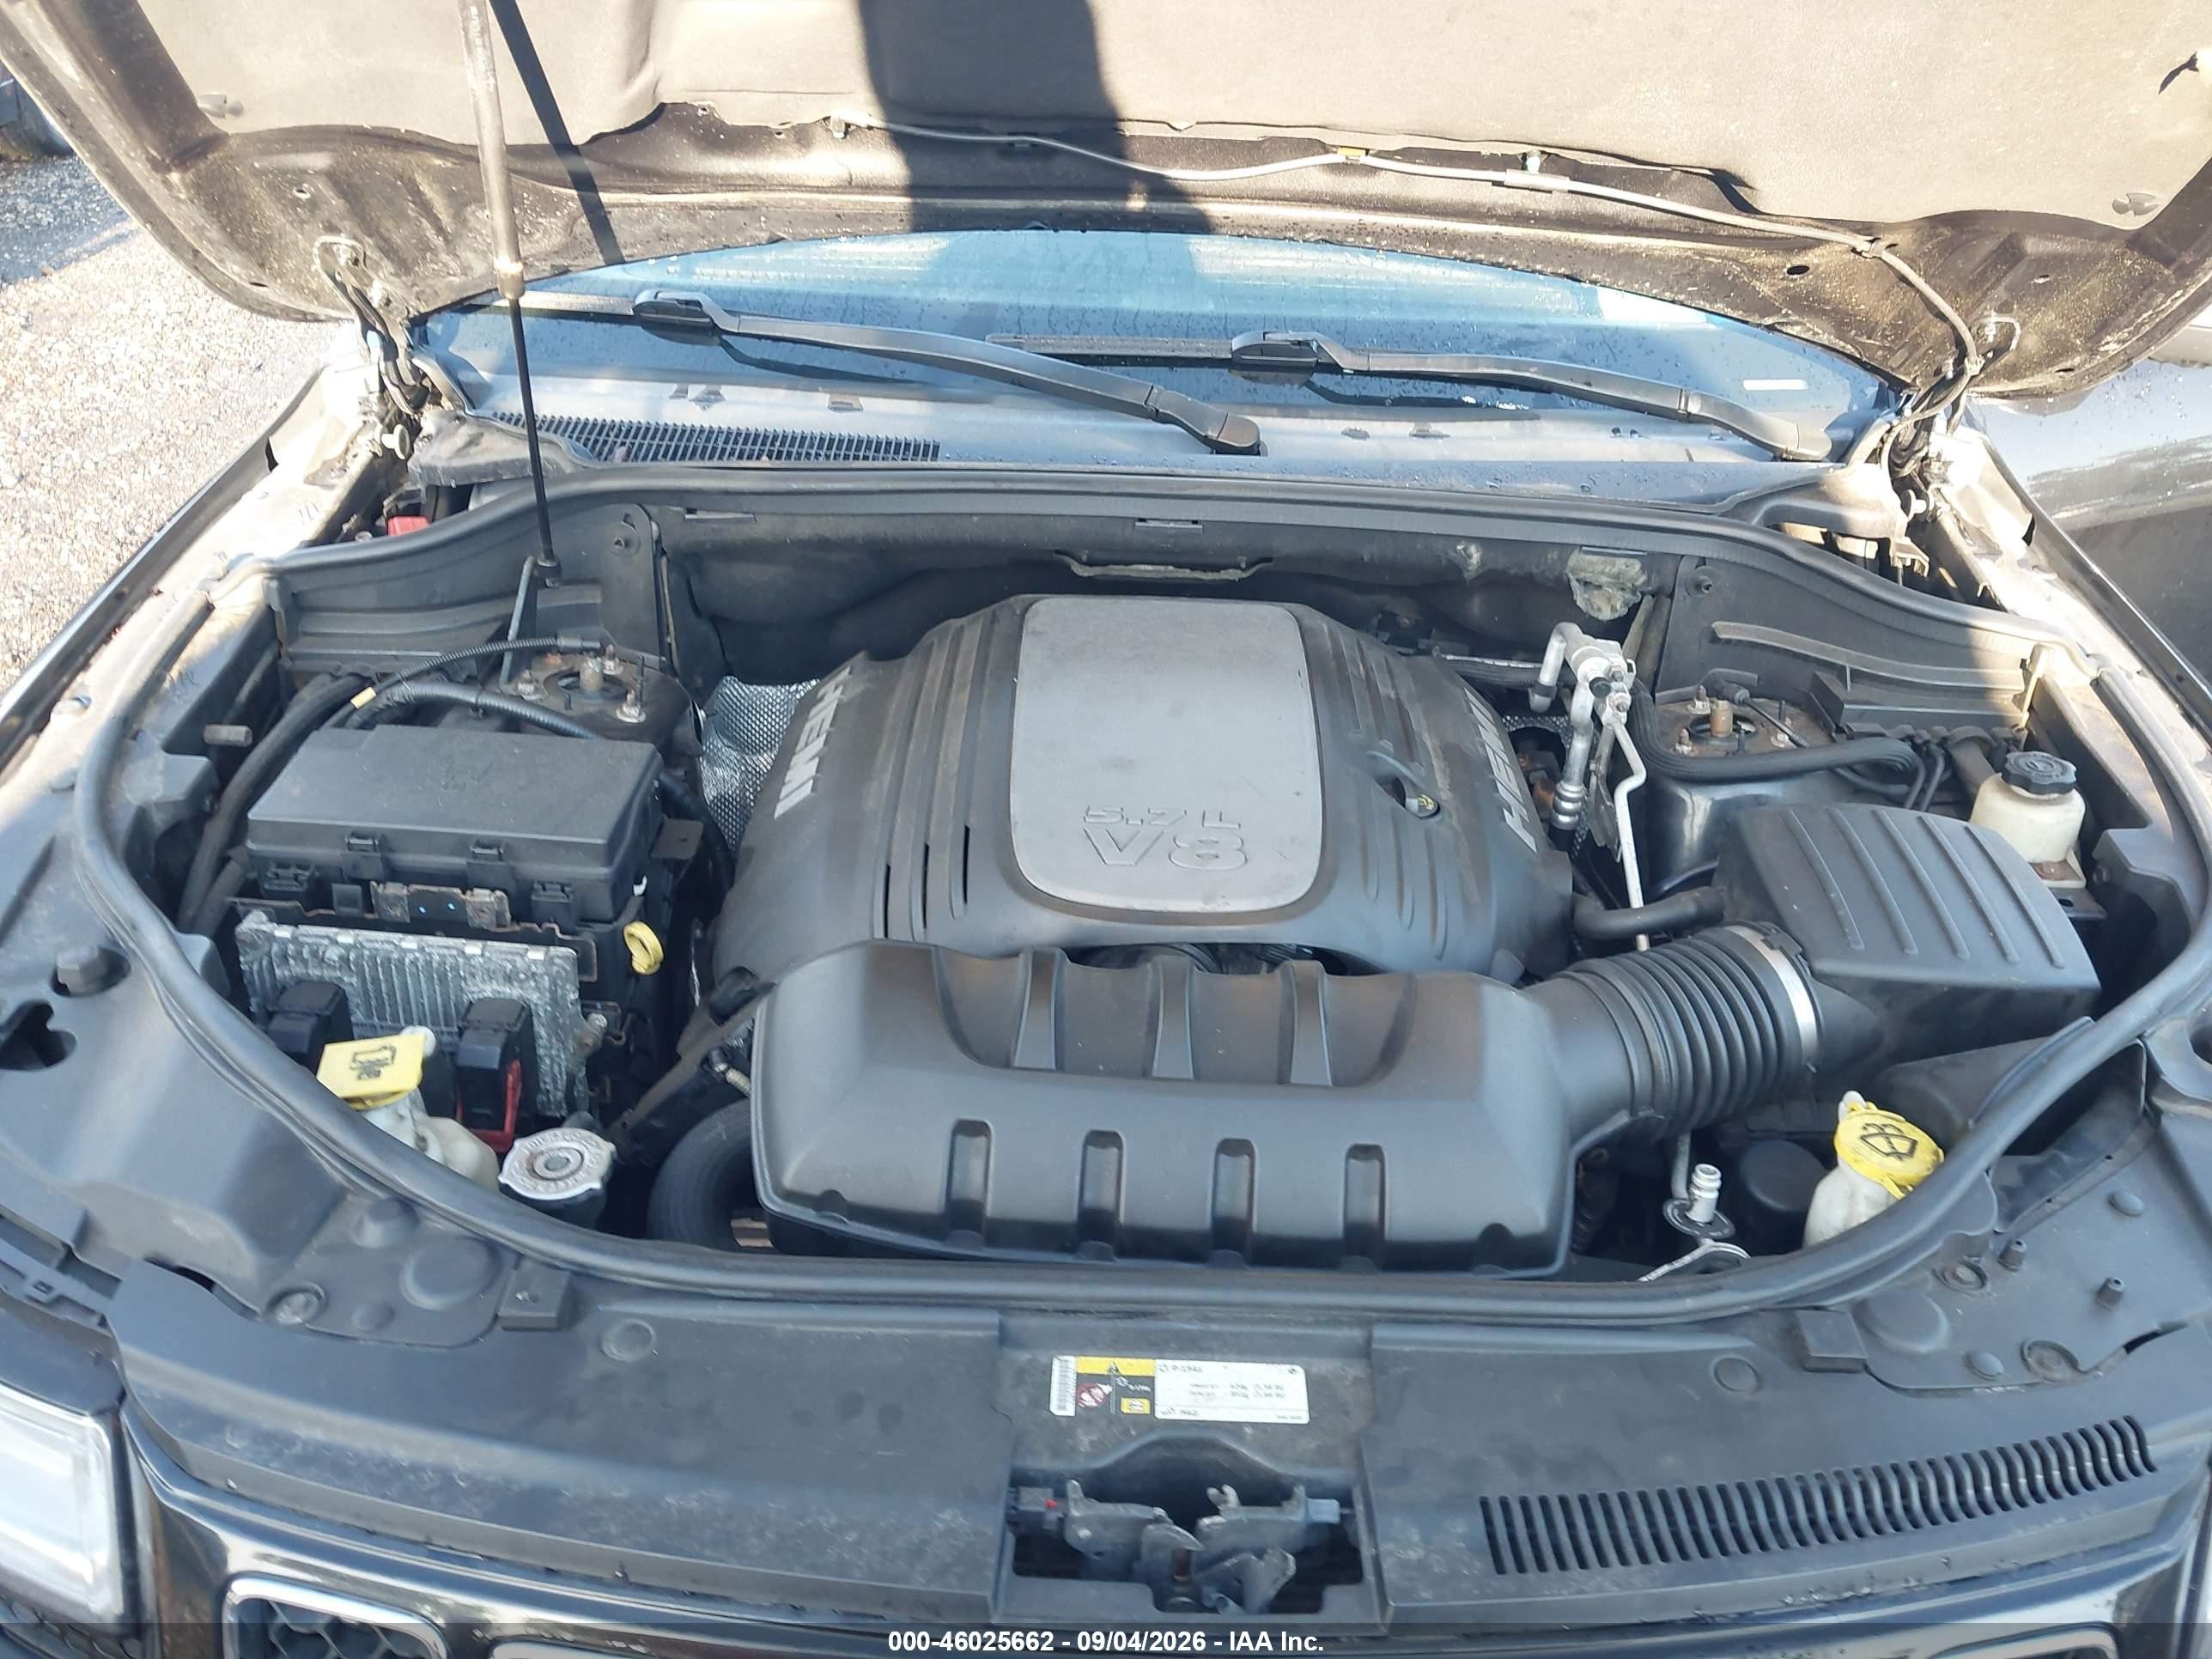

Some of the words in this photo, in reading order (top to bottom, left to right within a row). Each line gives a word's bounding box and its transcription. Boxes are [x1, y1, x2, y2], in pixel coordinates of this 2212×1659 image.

[775, 665, 850, 820] HEMI
[1463, 687, 1537, 853] HEMI
[1083, 827, 1248, 871] V8
